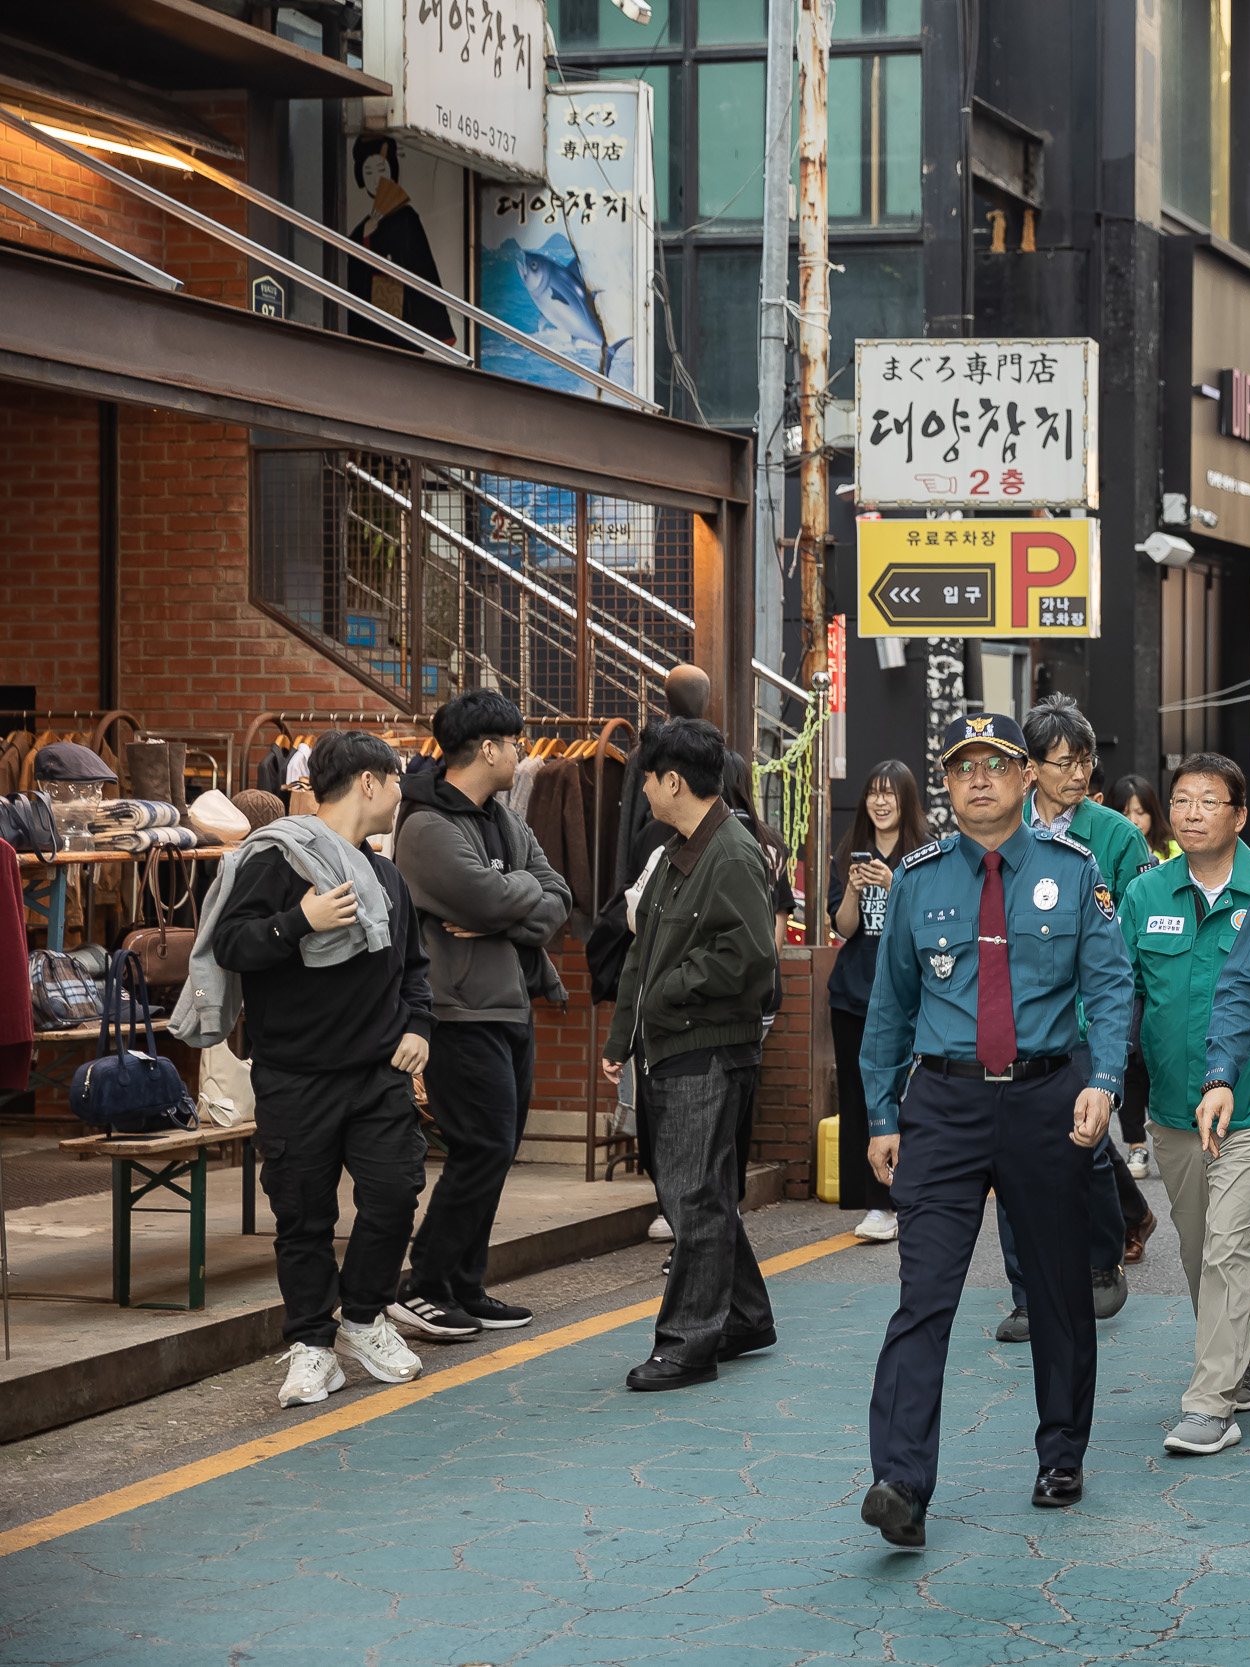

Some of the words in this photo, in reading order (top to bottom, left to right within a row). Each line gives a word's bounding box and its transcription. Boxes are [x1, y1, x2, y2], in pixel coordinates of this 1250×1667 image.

[418, 0, 532, 90] 대양참치
[436, 104, 452, 129] Tel
[457, 114, 517, 155] 469-3737
[567, 111, 616, 128] まぐろ
[561, 139, 624, 162] 専門店
[495, 191, 627, 225] 대양참치
[882, 351, 1058, 385] まぐろ専門店
[869, 397, 1073, 464] 대양참치
[906, 530, 996, 547] 유료주차장
[1011, 532, 1077, 628] P
[943, 586, 982, 604] 입구
[1041, 597, 1070, 611] 가나
[1041, 612, 1084, 627] 주차장
